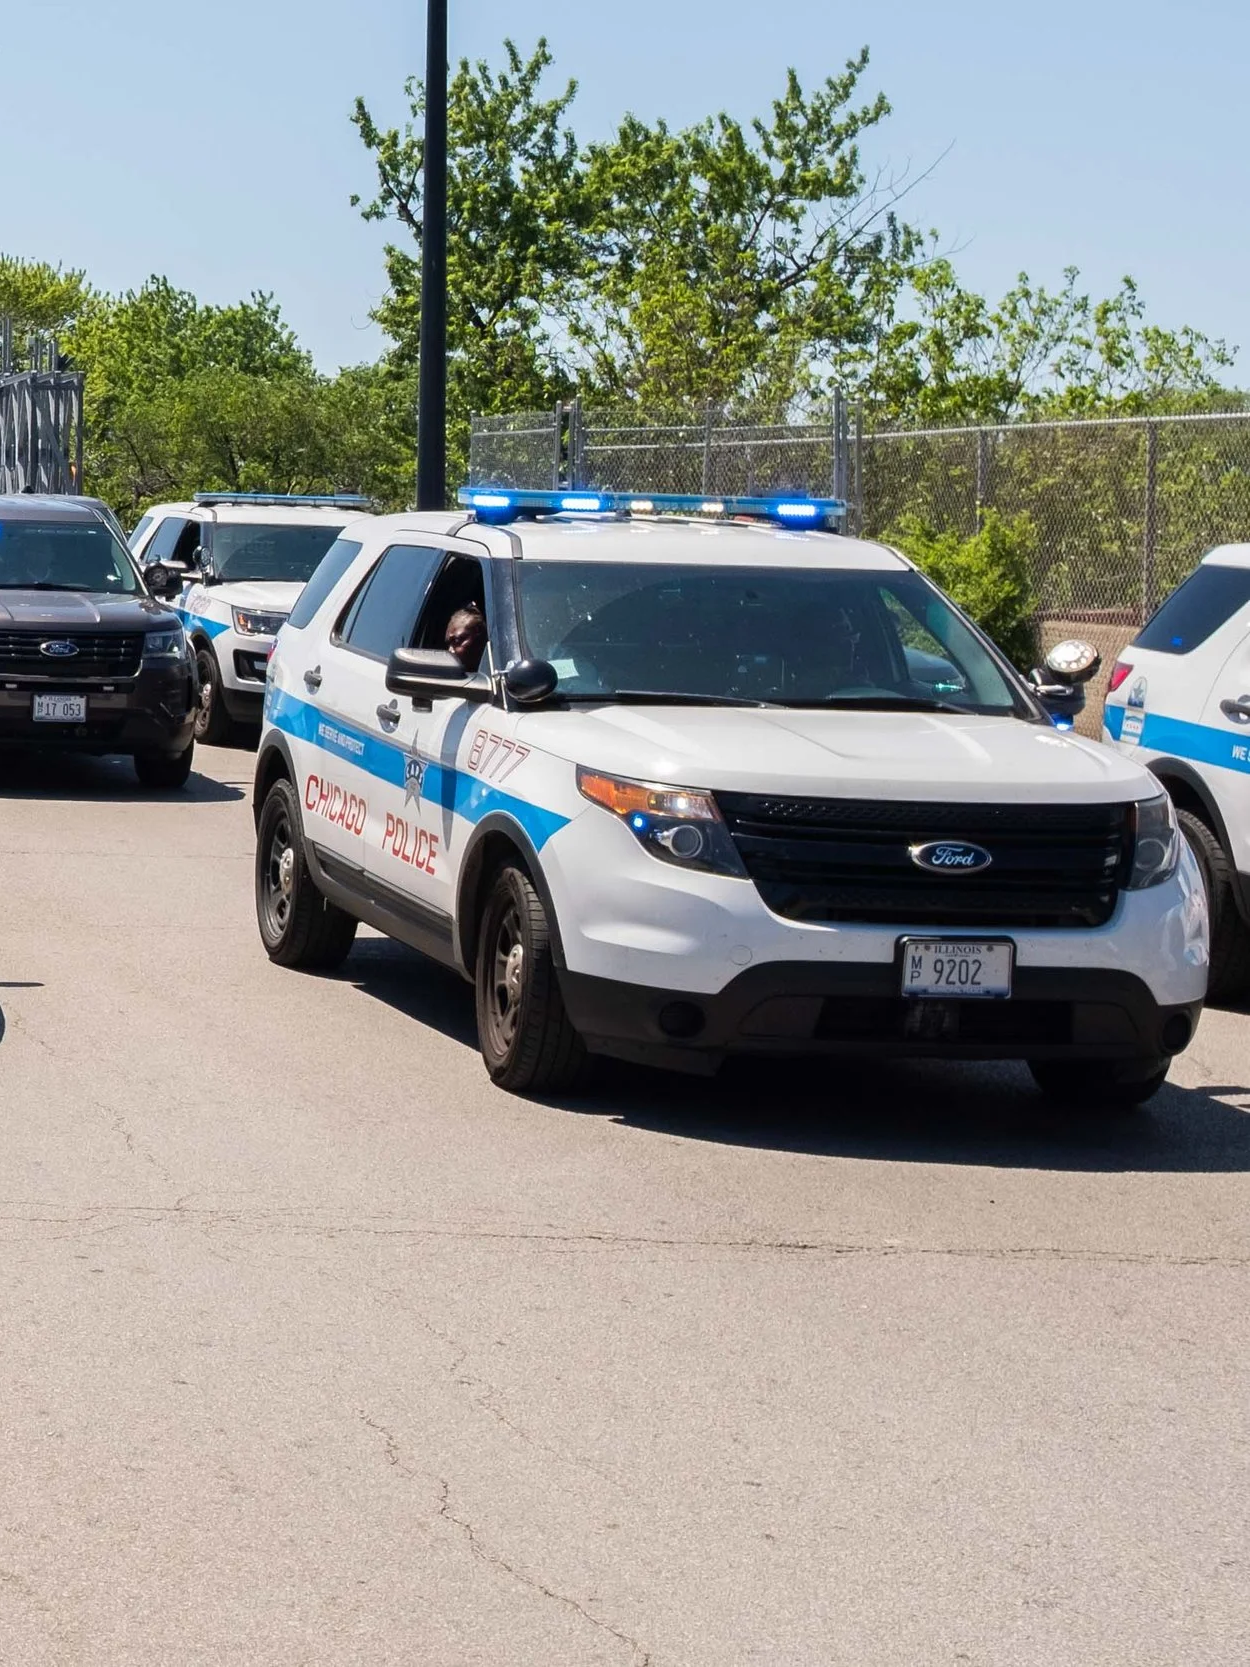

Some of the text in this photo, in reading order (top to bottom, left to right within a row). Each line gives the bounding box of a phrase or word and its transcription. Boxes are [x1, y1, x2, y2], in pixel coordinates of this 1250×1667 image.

[45, 703, 81, 716] 17 053
[468, 729, 530, 783] 8777
[305, 774, 439, 876] CHICAGO POLICE
[932, 846, 975, 865] Ford
[934, 945, 982, 955] ILLINOIS
[933, 959, 982, 986] 9202
